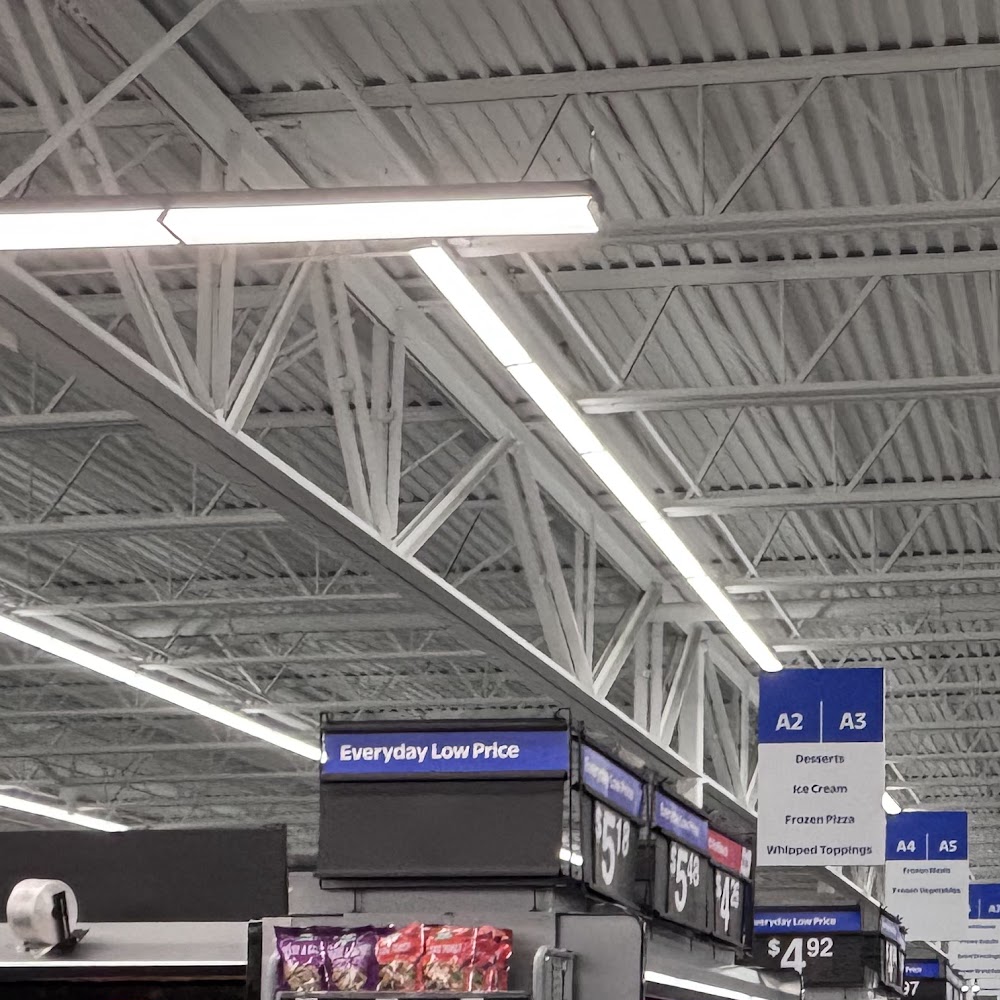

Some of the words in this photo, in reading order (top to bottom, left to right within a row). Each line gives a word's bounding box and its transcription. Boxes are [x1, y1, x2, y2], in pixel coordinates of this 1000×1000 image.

[775, 712, 803, 731] A2
[839, 712, 867, 730] A3
[340, 743, 428, 763] Everyday
[431, 743, 470, 760] Low
[472, 741, 520, 759] Price
[795, 754, 845, 764] Desserts
[793, 785, 809, 794] Ice
[811, 784, 848, 794] Cream
[785, 815, 824, 824] Frozen
[826, 815, 855, 824] Pizza
[767, 845, 817, 855] Whipped
[820, 845, 873, 857] Toppings
[896, 840, 916, 852] A4
[939, 840, 958, 852] A5
[754, 918, 791, 928] veryday
[793, 917, 812, 927] Low
[813, 917, 837, 926] Price
